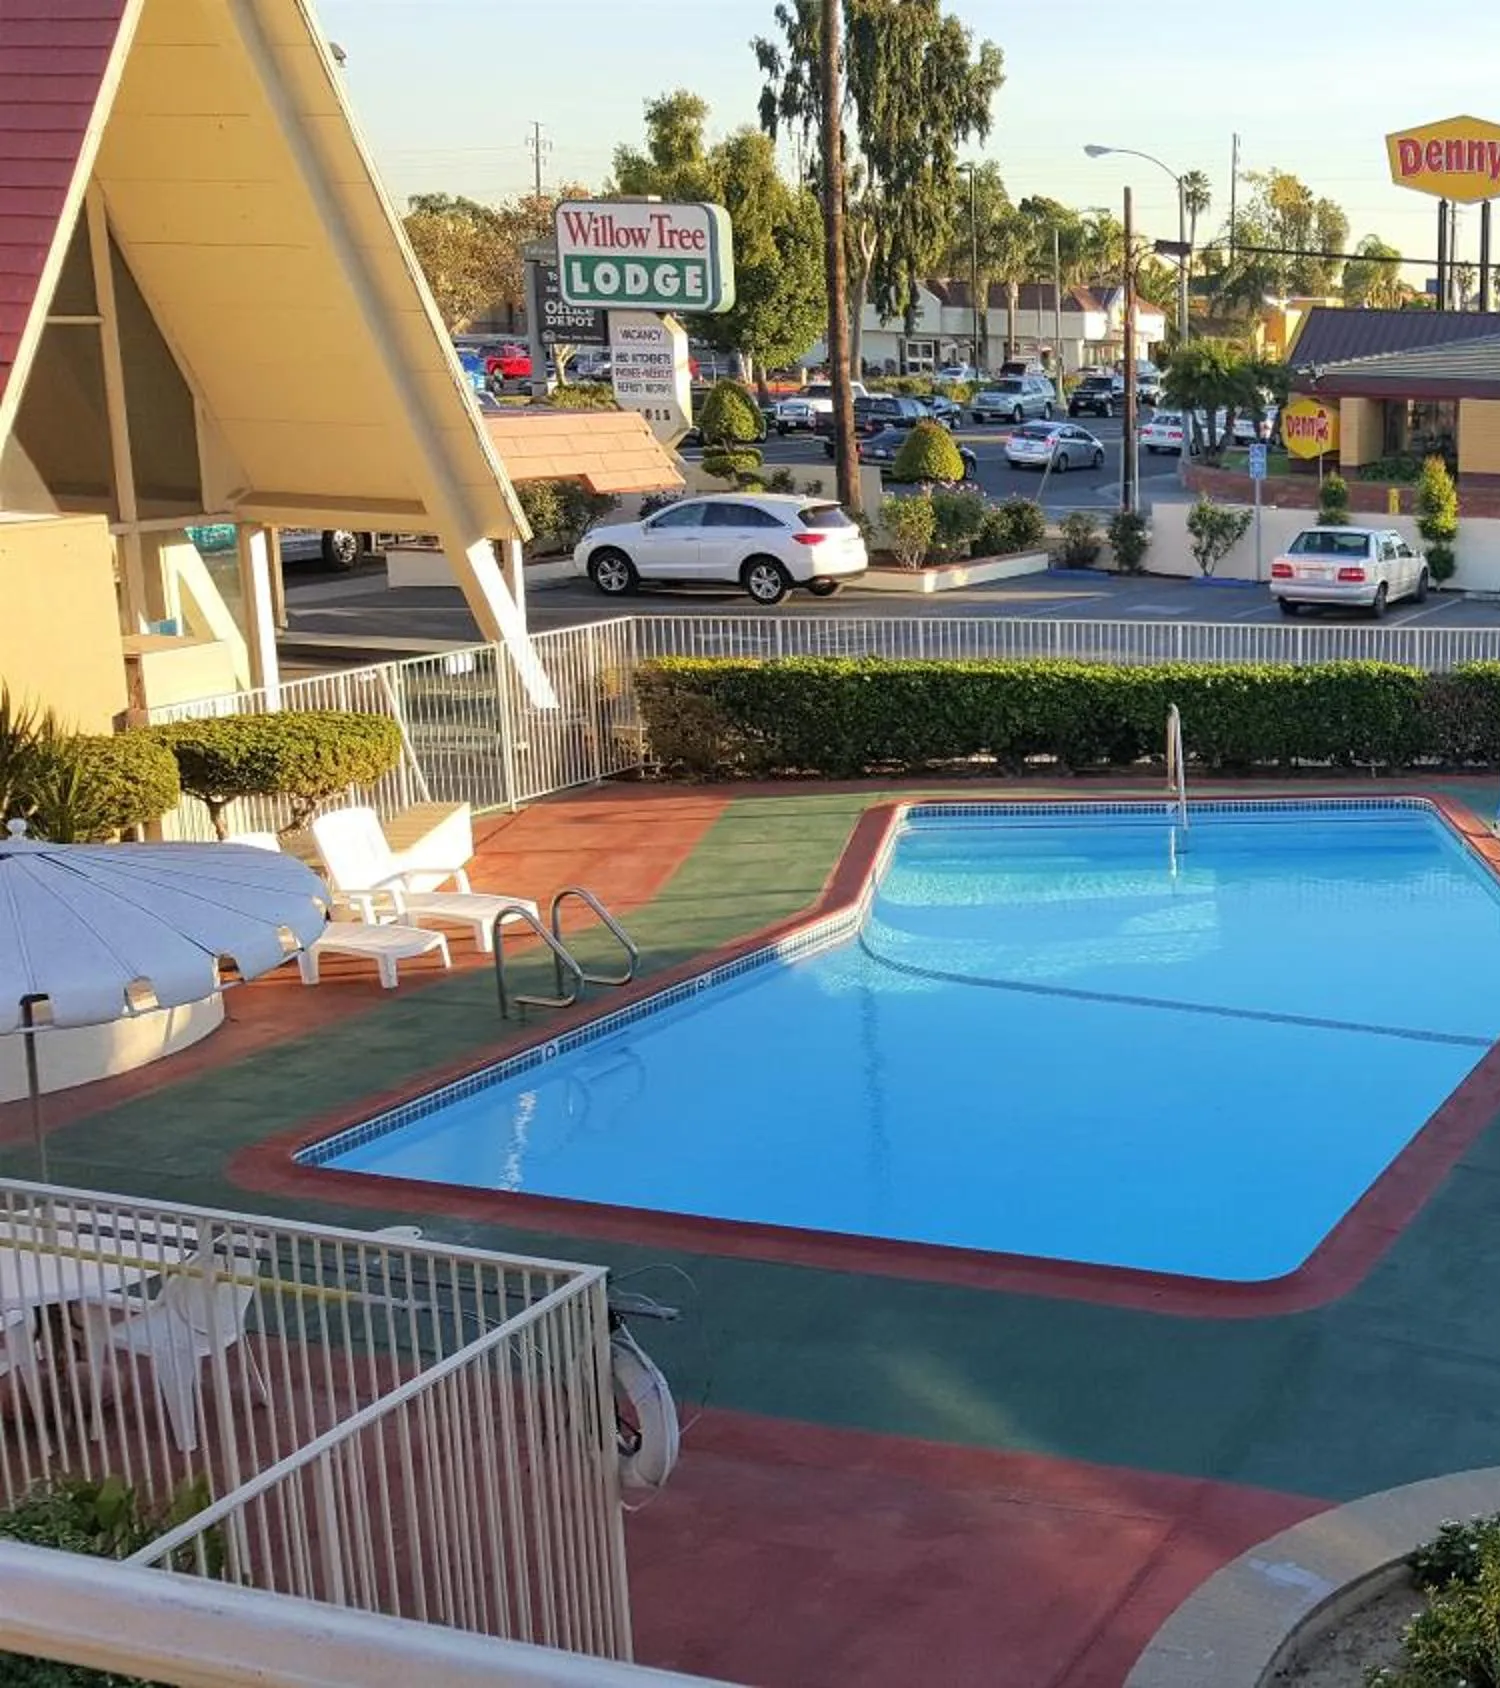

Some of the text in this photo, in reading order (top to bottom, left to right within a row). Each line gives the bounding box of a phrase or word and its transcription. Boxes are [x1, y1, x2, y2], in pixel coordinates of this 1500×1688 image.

[562, 211, 705, 251] Willow Tree
[570, 261, 703, 297] LODGE
[545, 315, 595, 327] DEPOT
